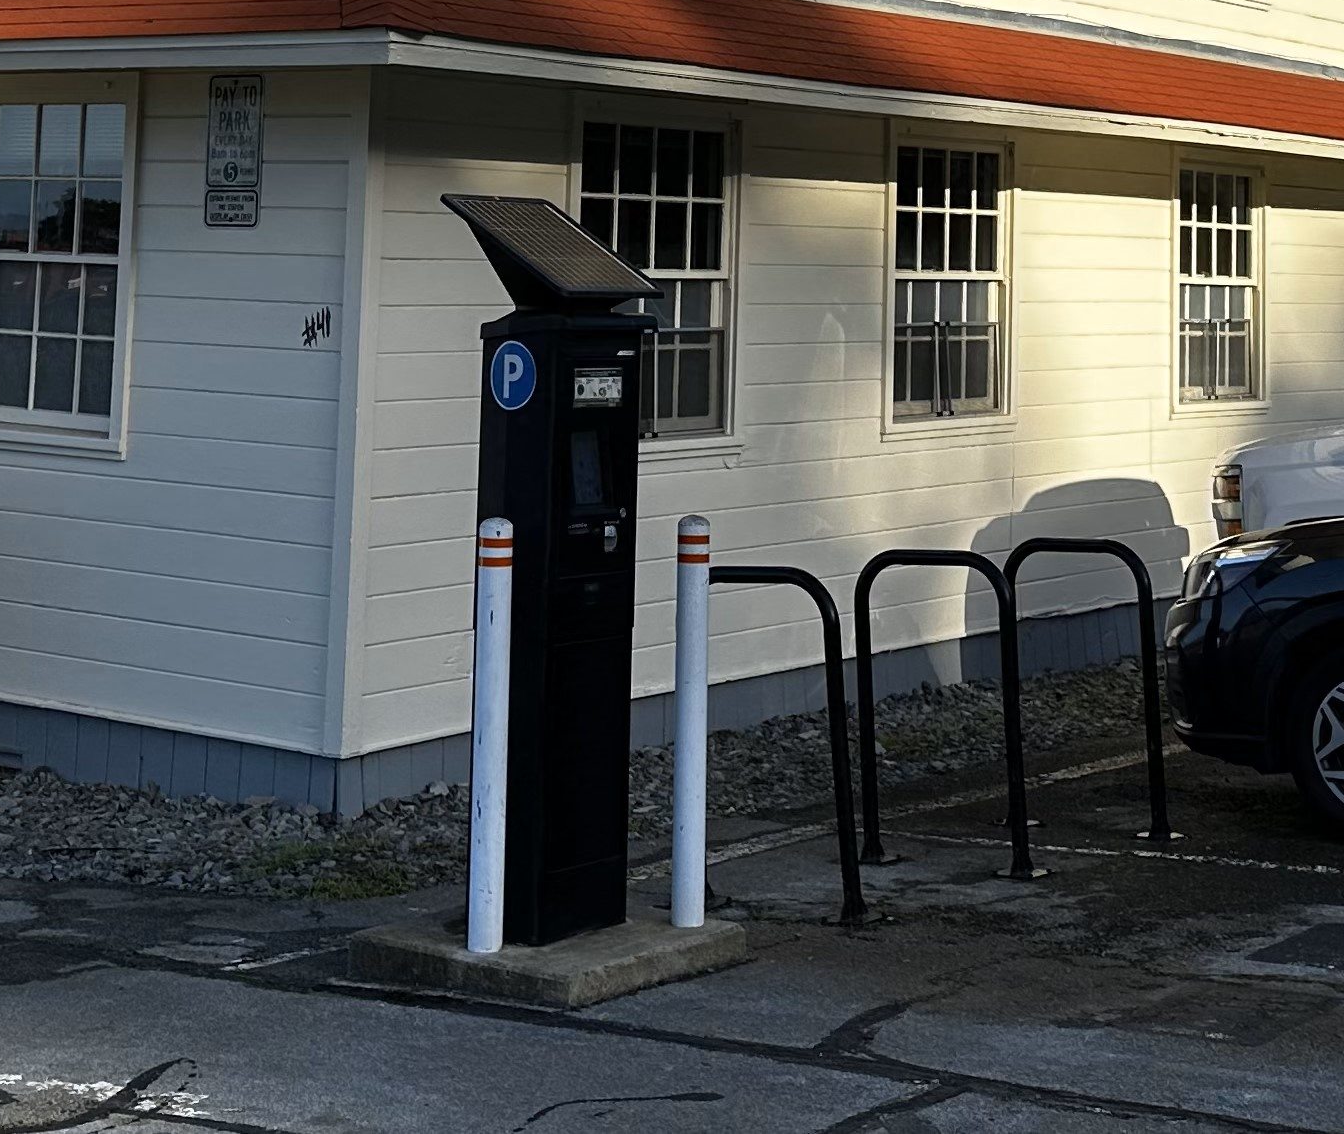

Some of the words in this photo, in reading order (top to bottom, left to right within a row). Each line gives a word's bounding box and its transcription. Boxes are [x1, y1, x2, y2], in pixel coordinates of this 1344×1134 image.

[215, 86, 237, 107] PAY
[242, 85, 257, 107] TO
[219, 110, 251, 133] PARK
[502, 353, 524, 399] P
